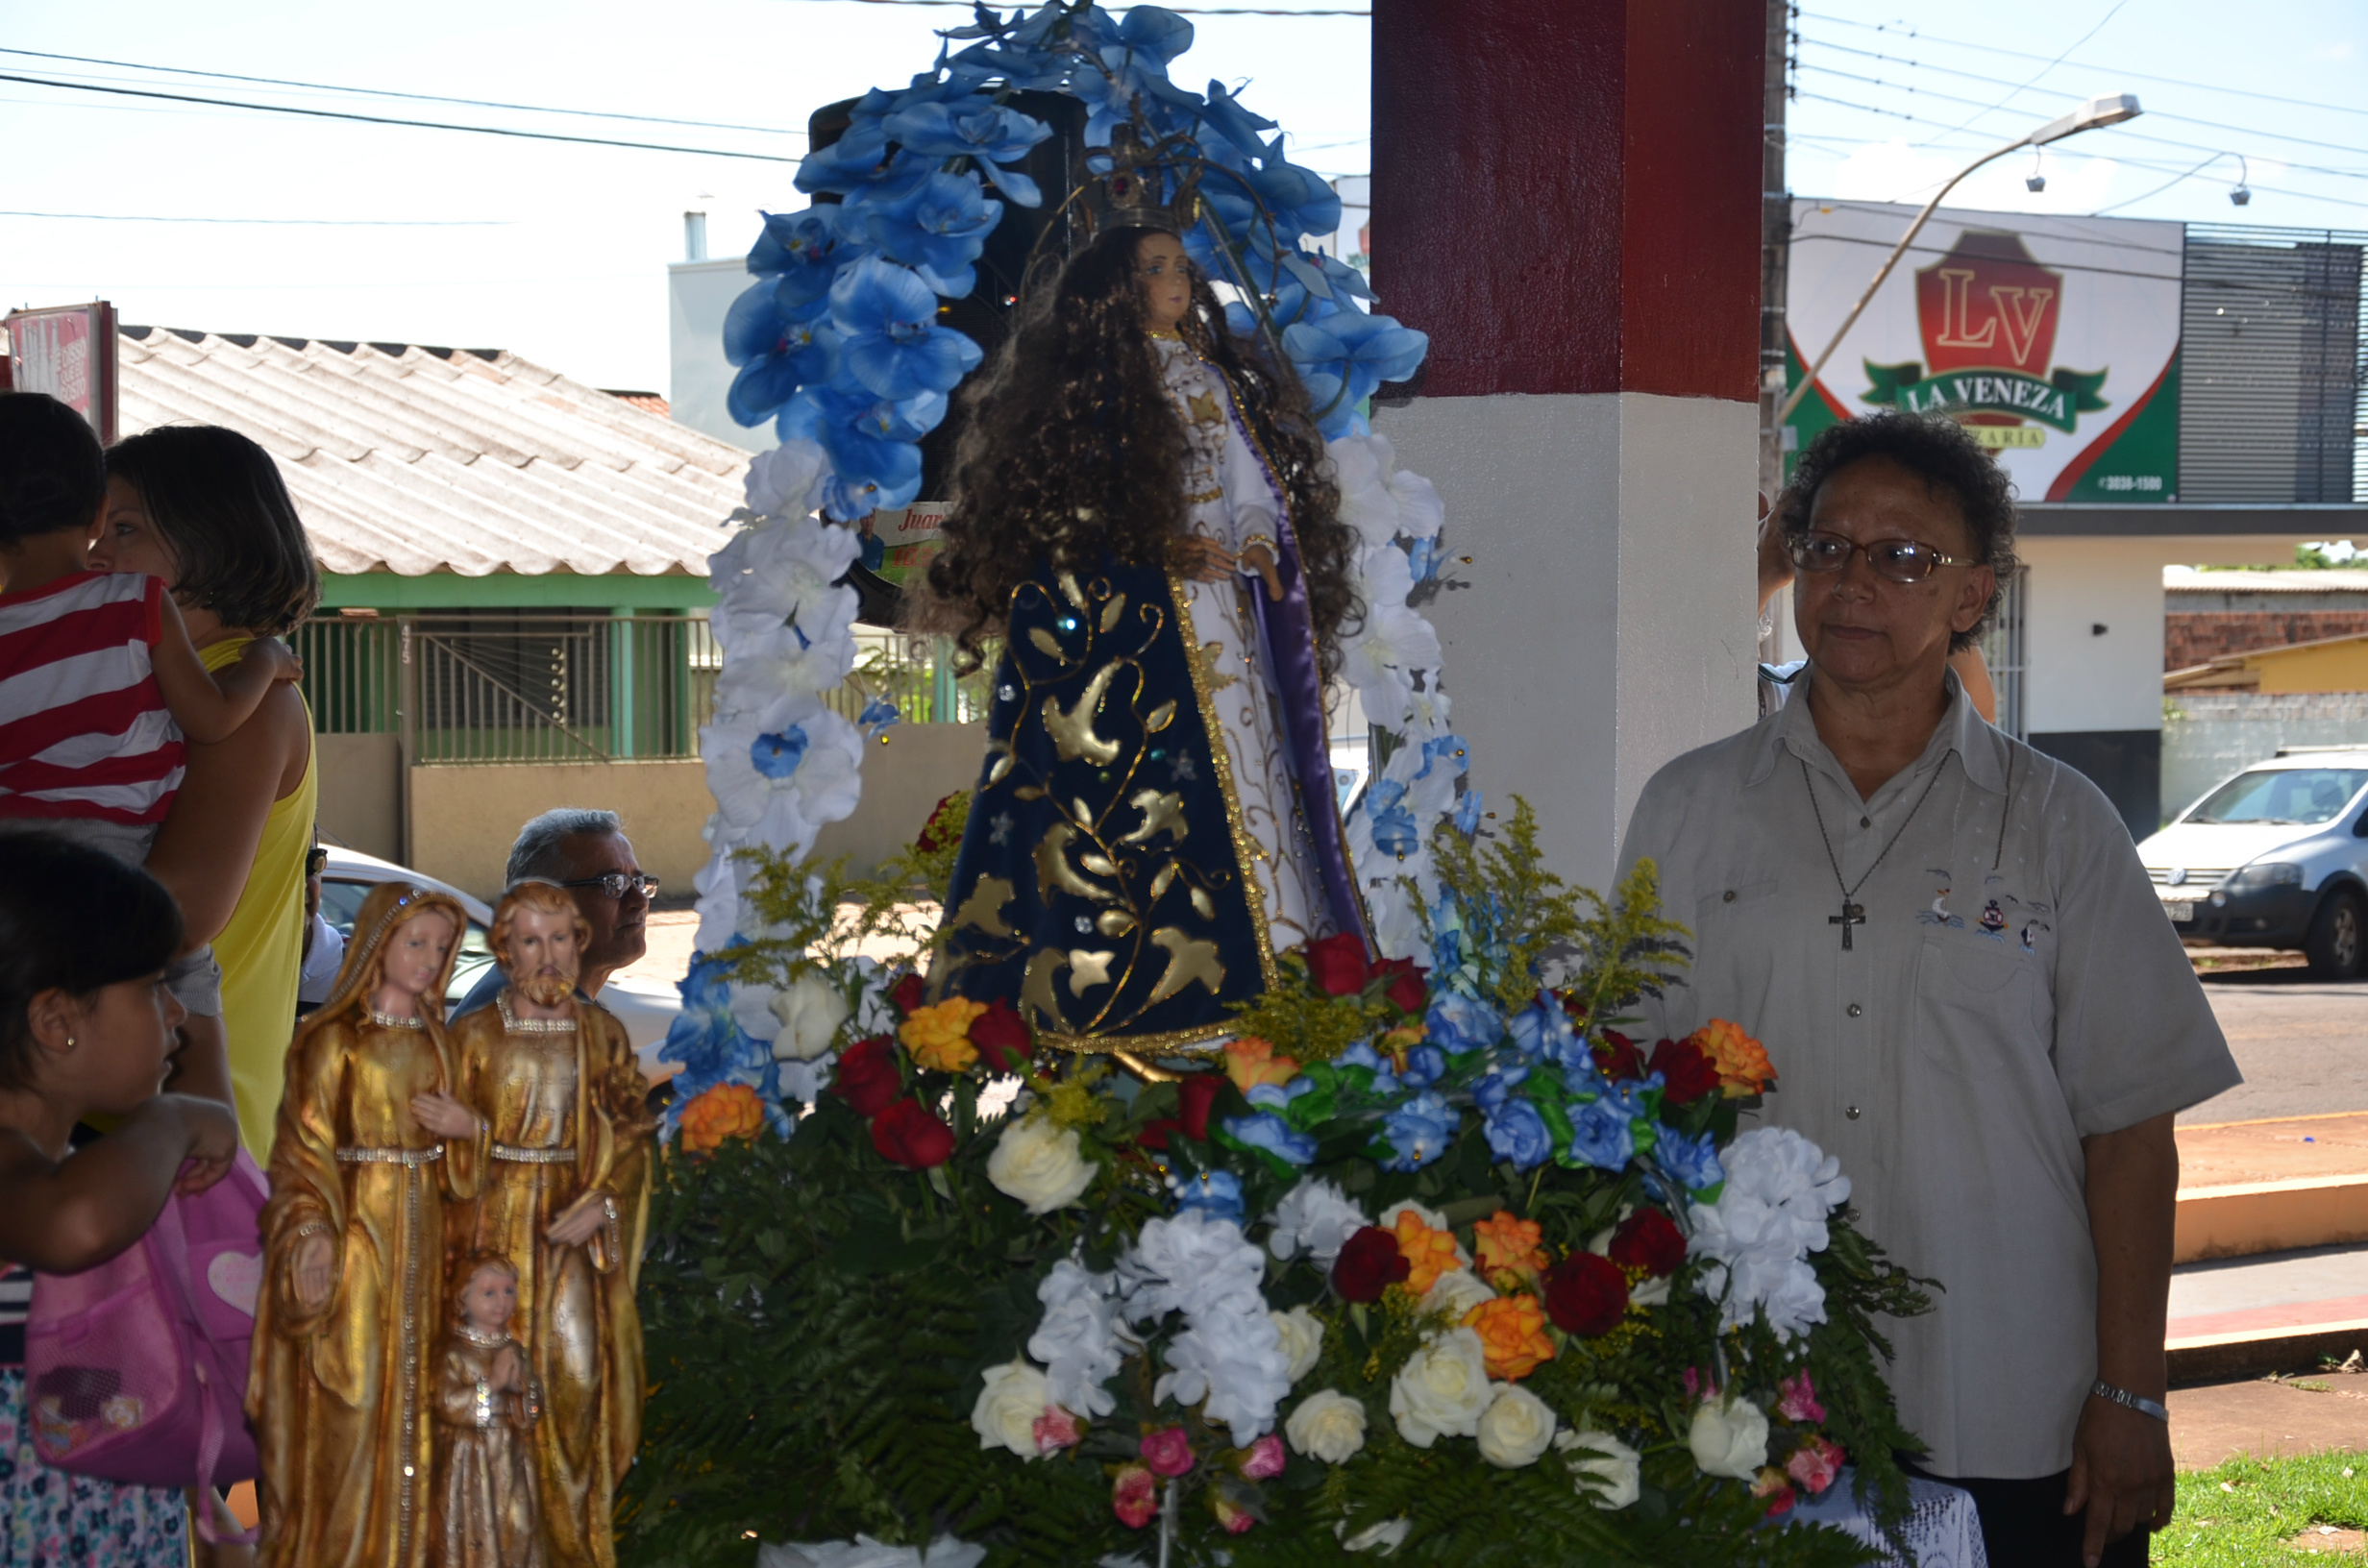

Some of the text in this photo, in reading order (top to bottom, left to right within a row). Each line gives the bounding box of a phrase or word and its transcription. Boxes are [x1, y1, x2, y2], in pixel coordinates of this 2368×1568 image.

[1936, 268, 2054, 366] LV
[62, 376, 86, 403] GOSTO
[1906, 376, 2065, 421] LA VENEZA
[898, 508, 944, 531] Juar
[891, 546, 935, 568] 103
